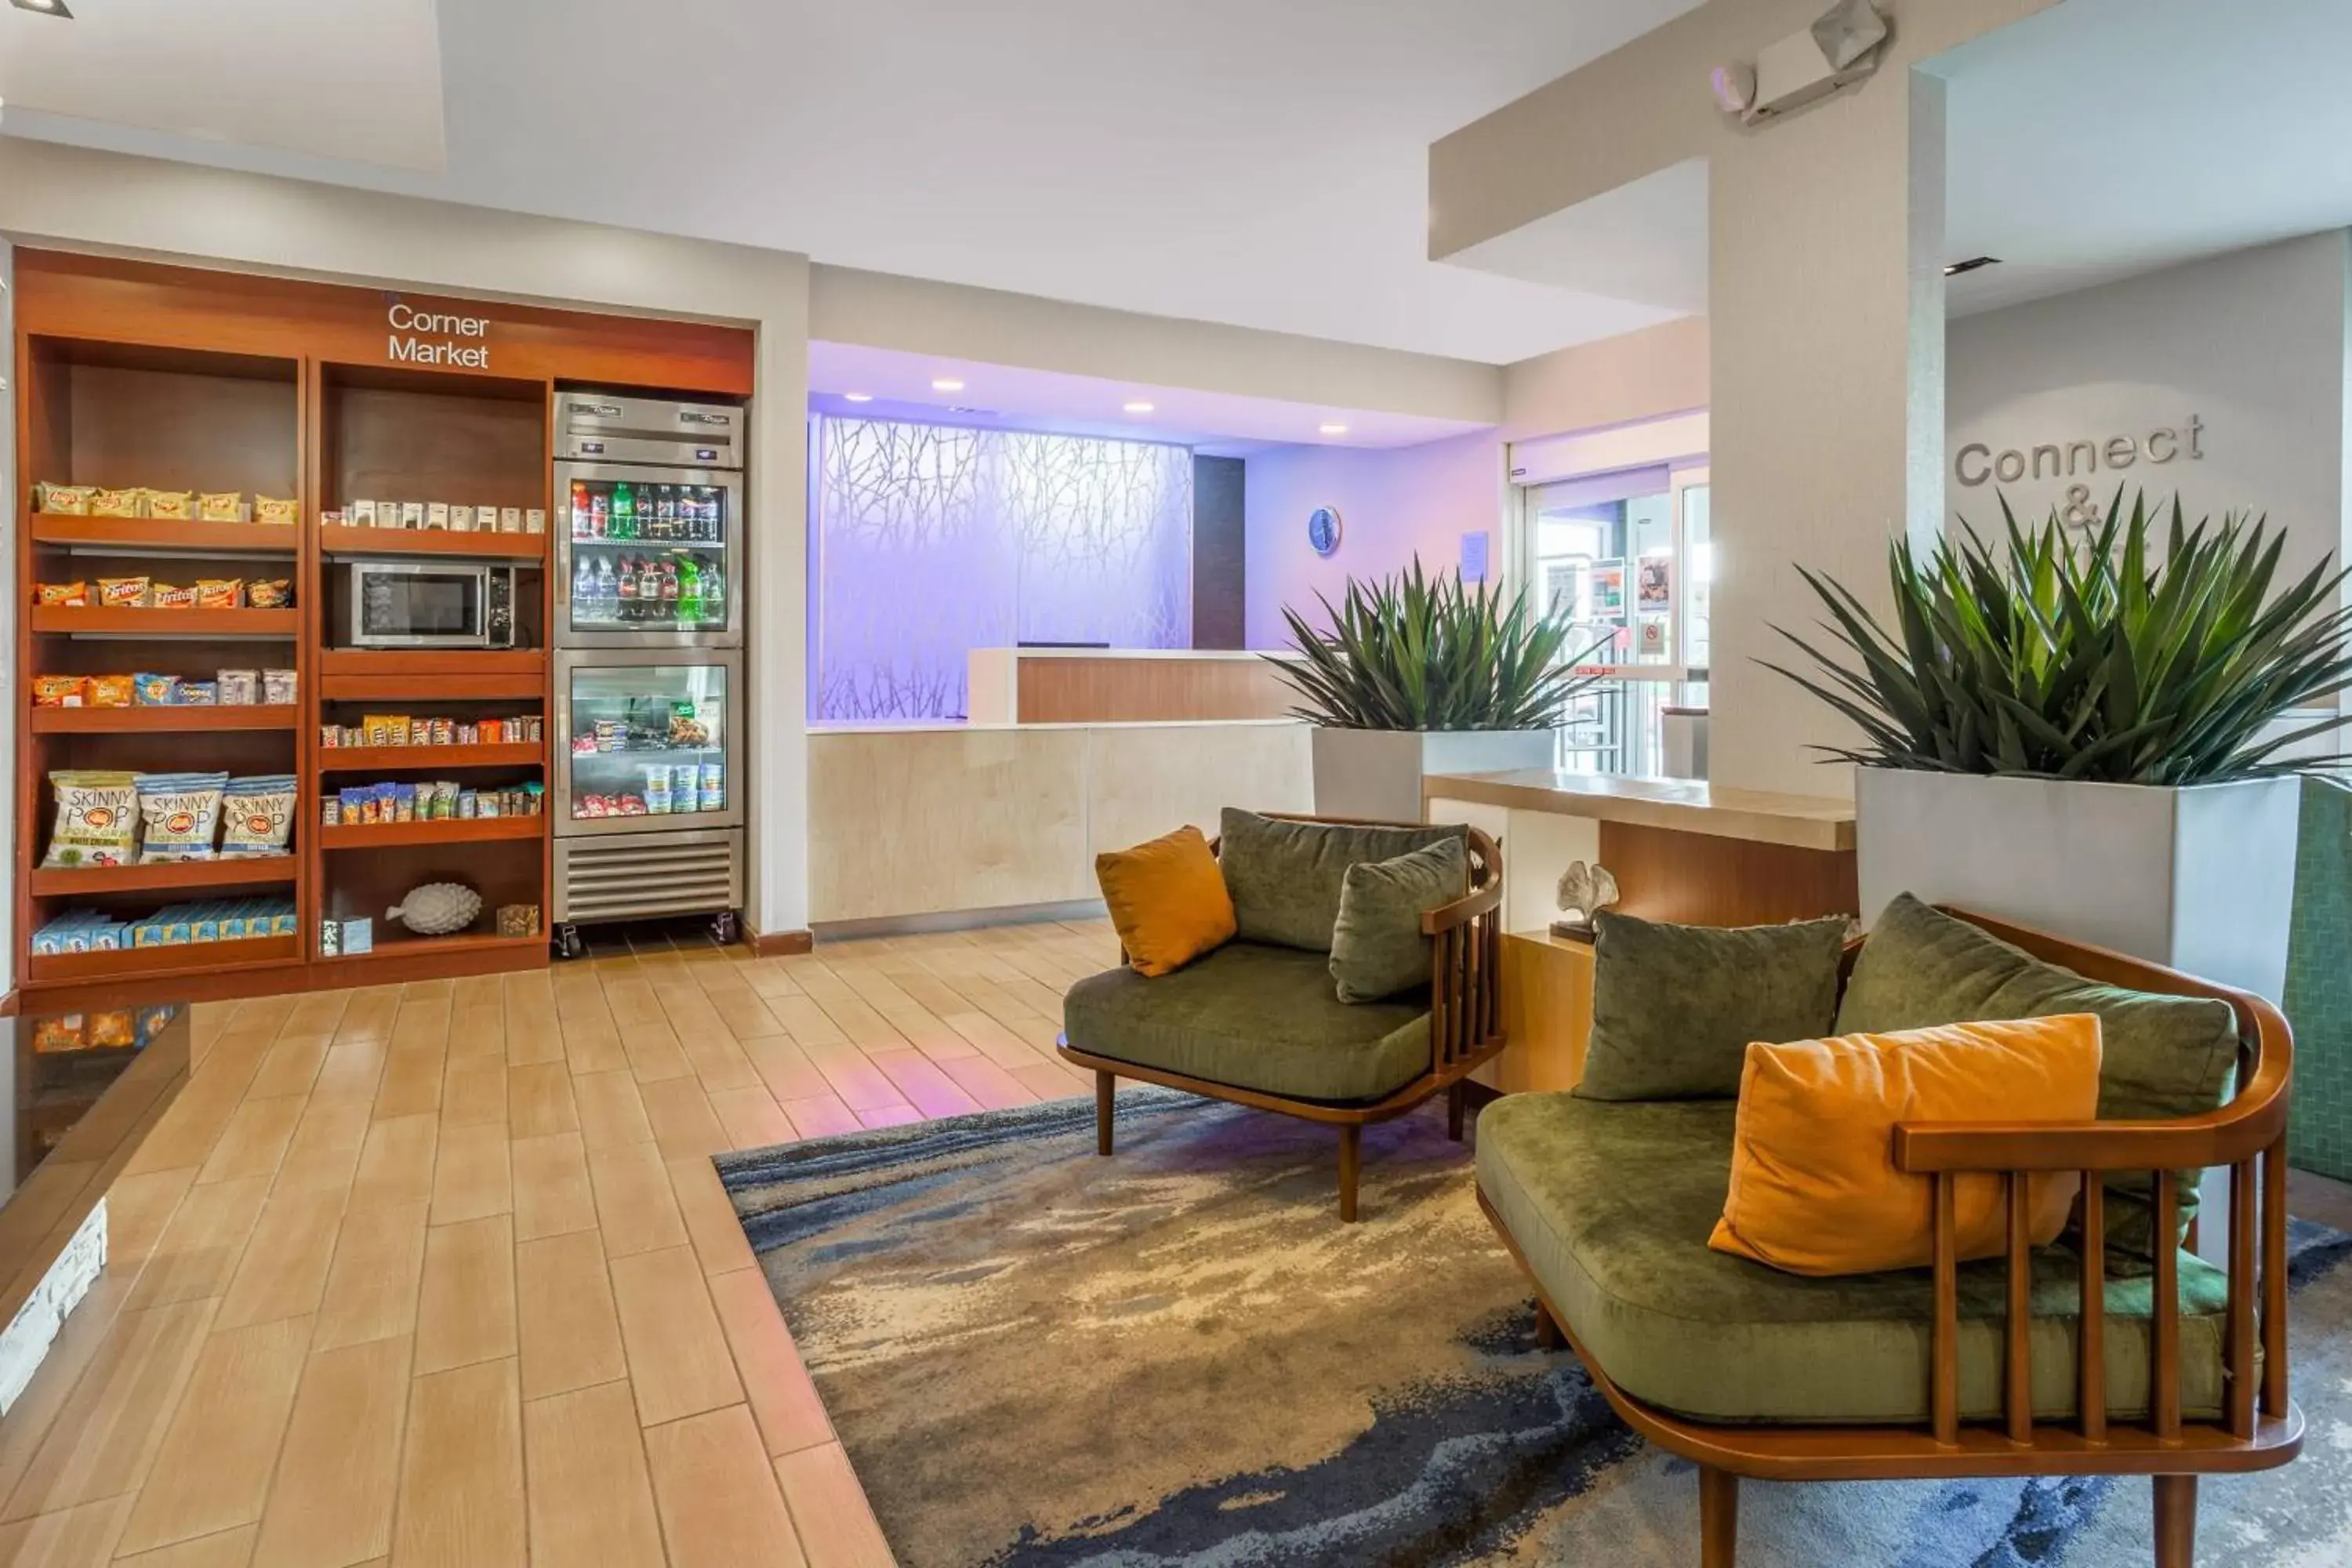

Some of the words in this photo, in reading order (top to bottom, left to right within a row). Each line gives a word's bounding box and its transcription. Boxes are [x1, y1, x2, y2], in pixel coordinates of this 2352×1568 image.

[388, 303, 490, 338] Corner
[389, 334, 489, 369] Market
[1955, 413, 2205, 488] Connect
[2062, 483, 2101, 530] &
[71, 788, 133, 808] SKINNY
[153, 794, 213, 812] SKINNY
[232, 797, 285, 814] SKINNY
[66, 805, 129, 829] POP
[152, 810, 211, 834] POP
[232, 812, 285, 836] POP
